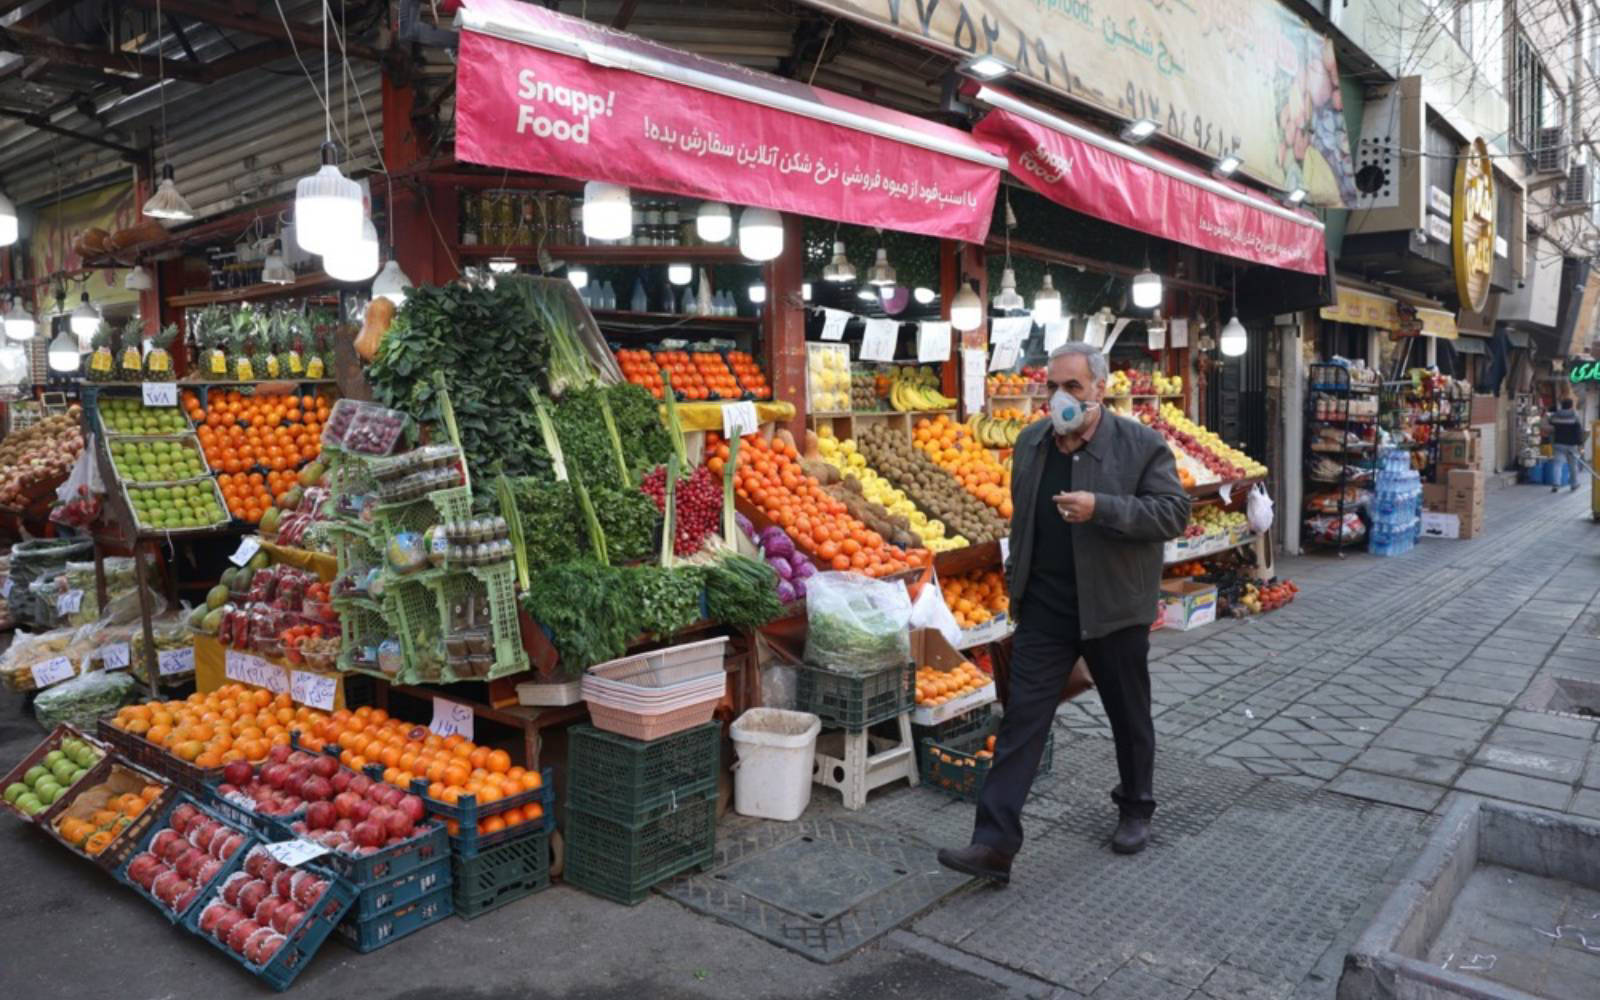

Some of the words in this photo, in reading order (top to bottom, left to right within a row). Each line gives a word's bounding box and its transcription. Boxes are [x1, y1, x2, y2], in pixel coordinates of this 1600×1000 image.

[518, 69, 616, 120] Snapp!
[516, 104, 590, 144] Food
[643, 115, 677, 150] بده!
[679, 126, 734, 157] سفارش
[737, 143, 780, 168] آنلاین
[779, 152, 812, 173] شکن
[814, 156, 839, 185] نرخ
[841, 165, 881, 191] فروشی
[882, 177, 908, 198] میوه
[908, 179, 919, 200] از
